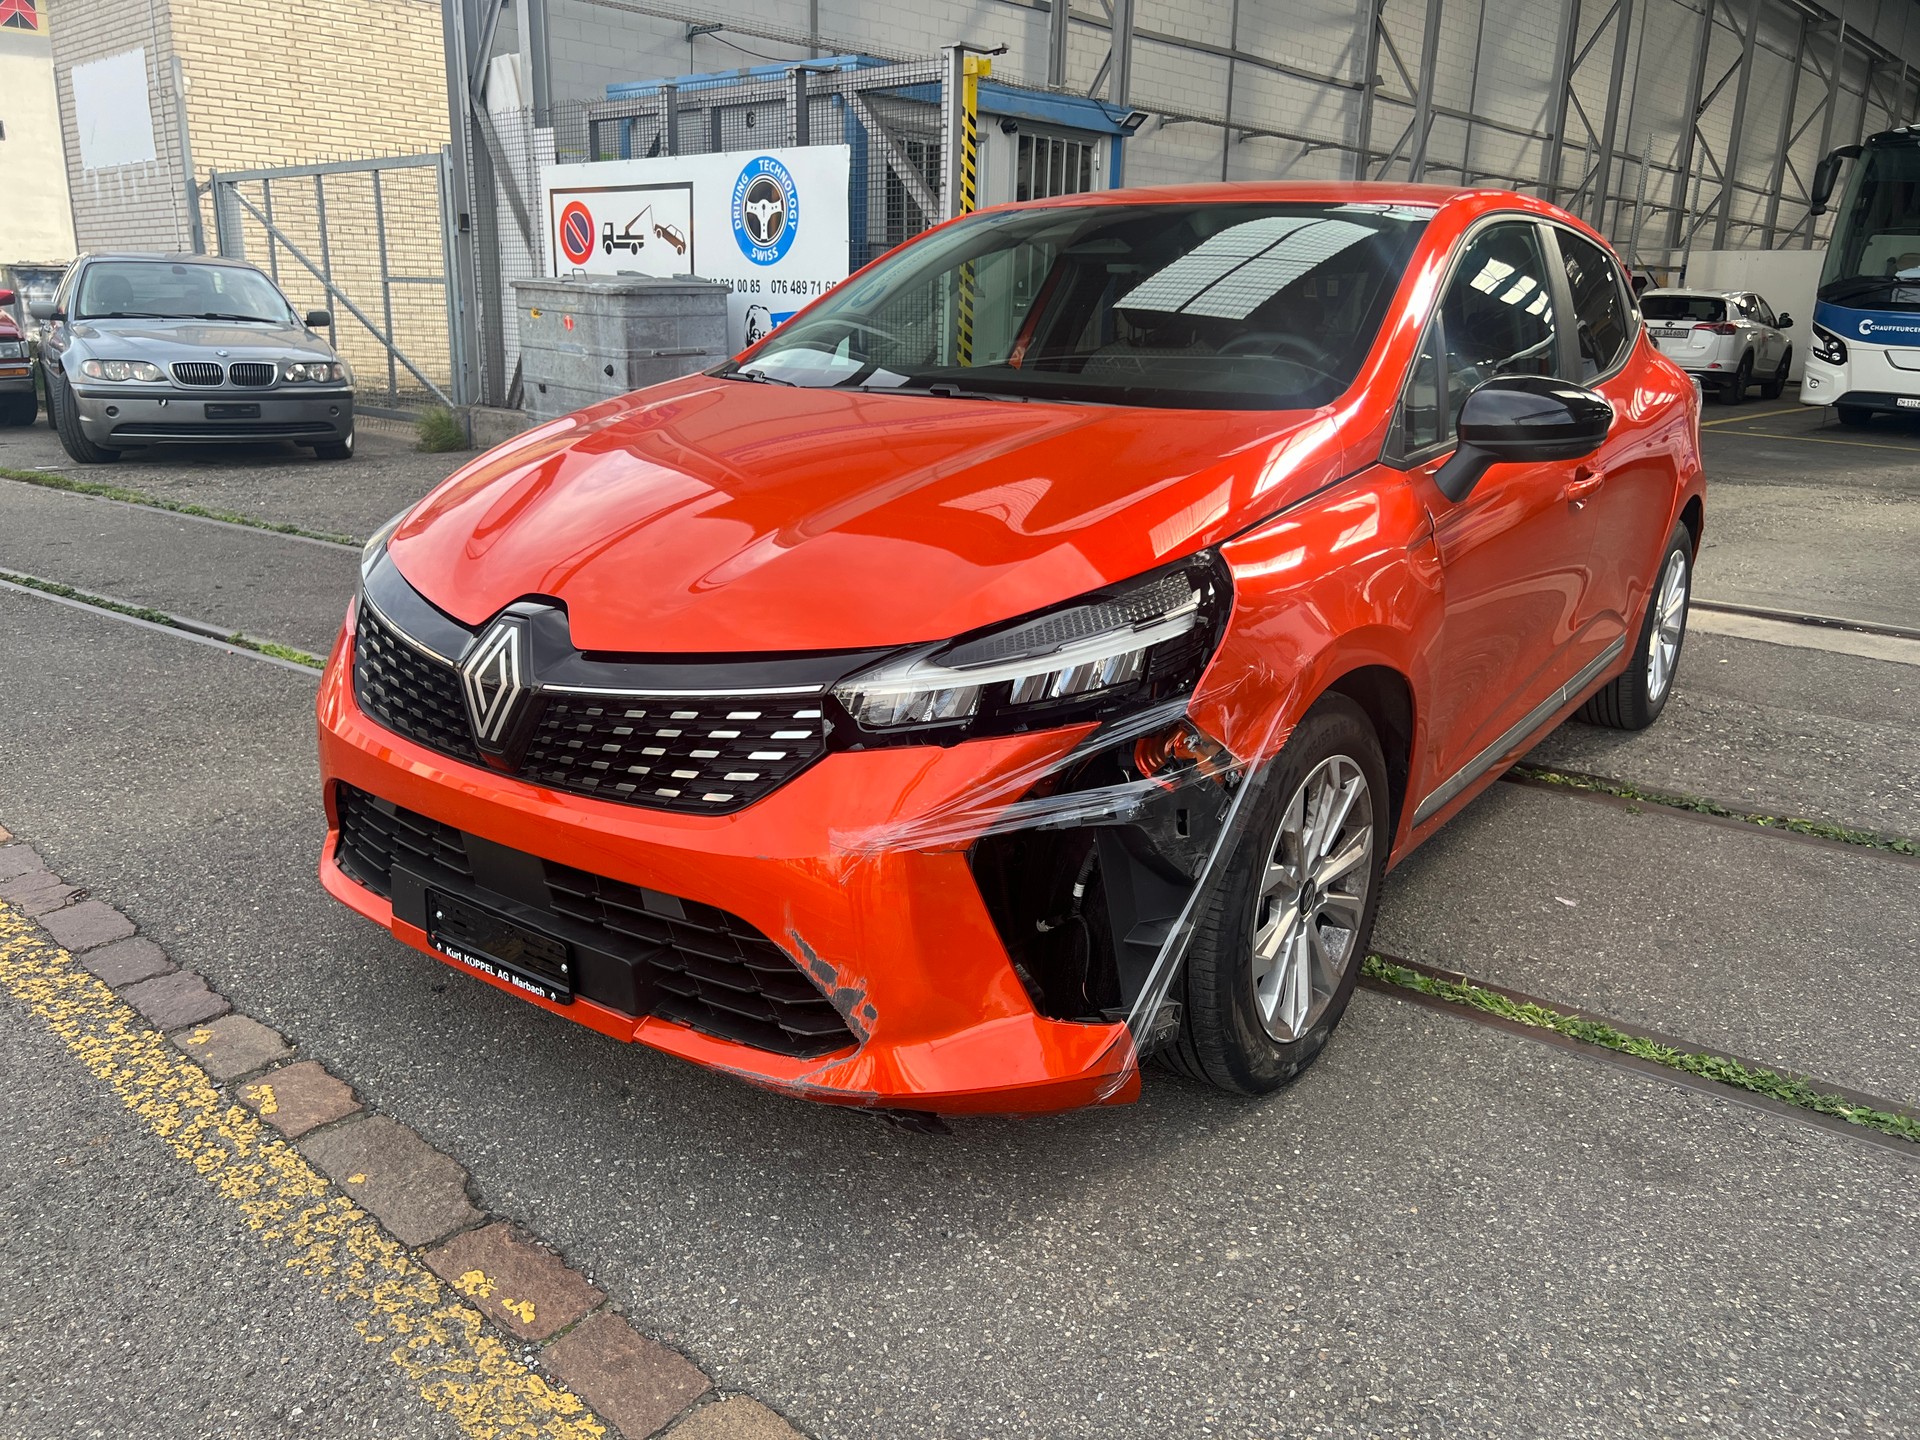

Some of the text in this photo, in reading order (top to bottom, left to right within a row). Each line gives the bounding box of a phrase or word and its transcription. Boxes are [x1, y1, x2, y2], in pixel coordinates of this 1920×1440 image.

[733, 173, 749, 231] DRIVING
[758, 160, 797, 230] TECHNOLOGY
[751, 247, 779, 261] SWISS
[737, 279, 748, 293] 00
[750, 279, 761, 293] 85
[771, 280, 788, 294] 076
[790, 280, 808, 295] 489
[810, 280, 821, 296] 71
[446, 946, 462, 962] Kurt
[497, 969, 509, 982] AG
[512, 975, 545, 998] Marbach
